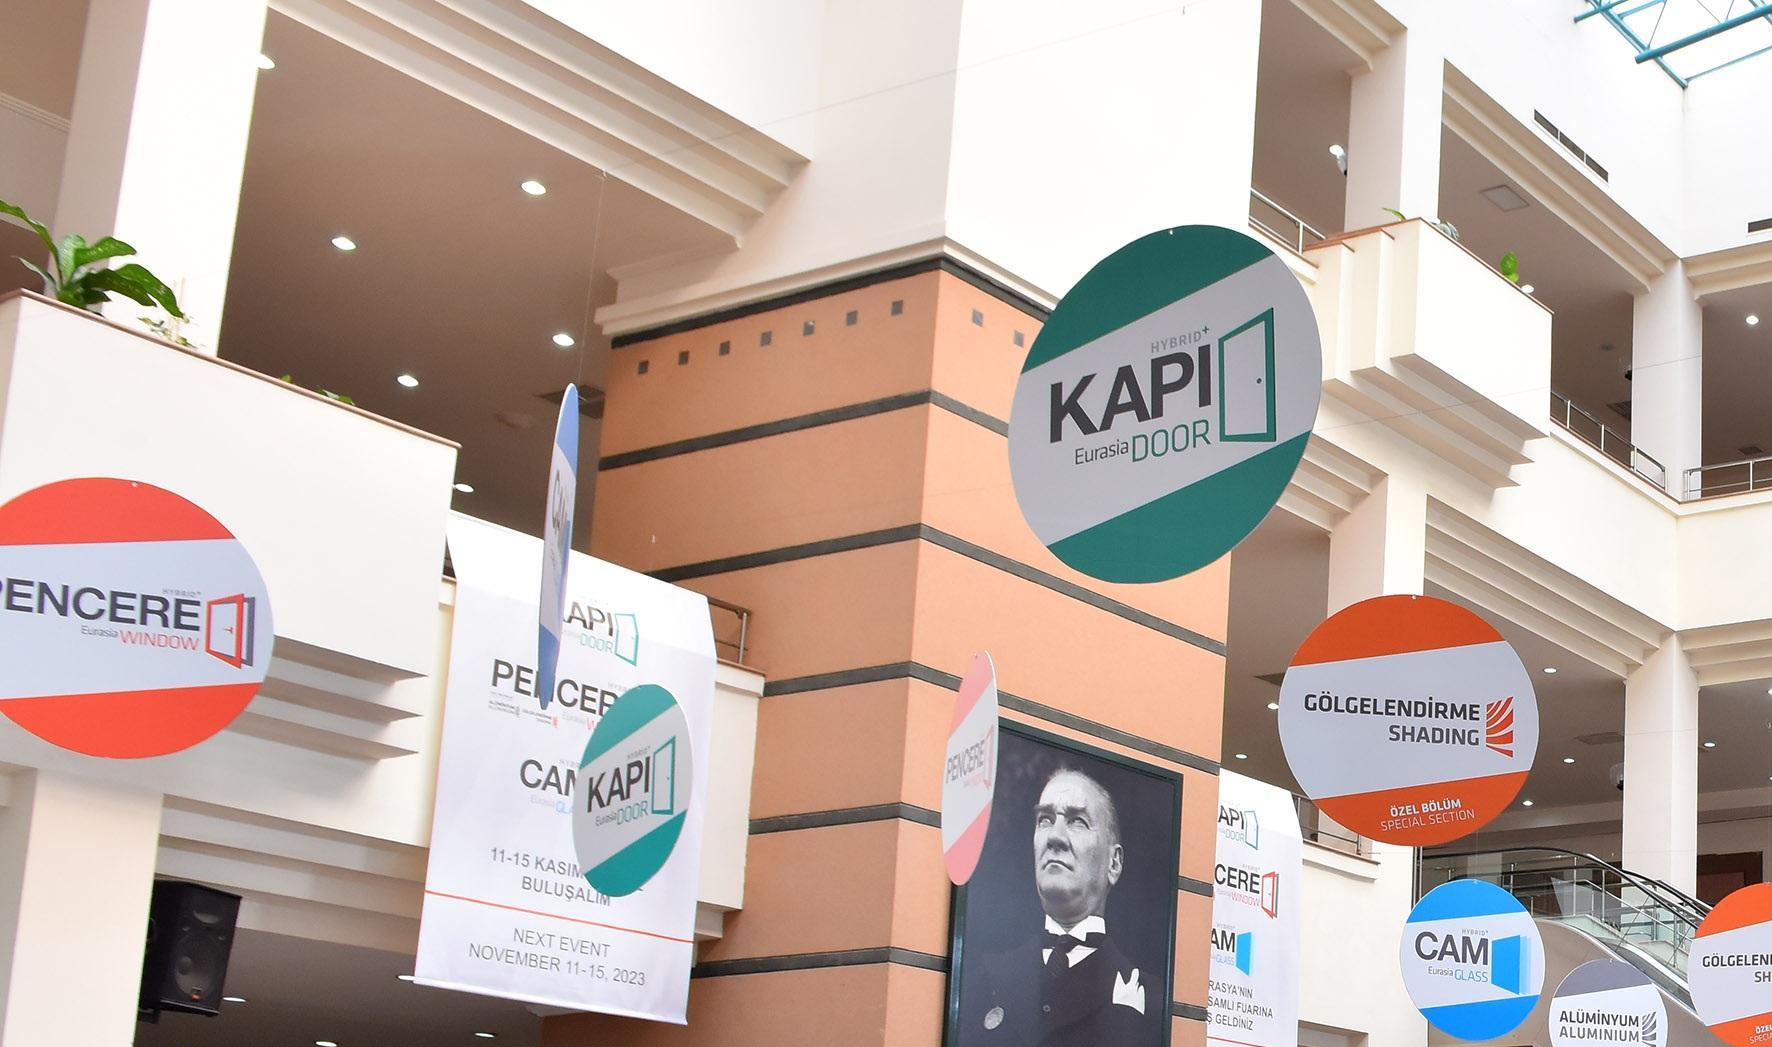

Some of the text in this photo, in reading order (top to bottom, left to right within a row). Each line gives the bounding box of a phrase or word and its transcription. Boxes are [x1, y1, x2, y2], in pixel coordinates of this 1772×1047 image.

[1050, 344, 1211, 443] KAPI
[1075, 419, 1211, 465] Eurasia DOOR
[0, 577, 201, 632] ENCERE
[562, 601, 614, 637] API
[81, 625, 200, 651] Eurasia WINDOW
[1304, 691, 1480, 721] GÖLGELENDİRME
[1389, 725, 1479, 746] SHADING
[586, 756, 651, 813] KAPI
[595, 801, 649, 827] Eurasia DOOR
[1218, 804, 1245, 830] API
[1380, 809, 1475, 832] SPECIAL SECTION
[1390, 799, 1461, 817] ÖZEL BÖLÜM
[491, 848, 530, 868] 11-15
[1214, 864, 1261, 895] CERE
[513, 928, 611, 958] NEXT EVENT
[1211, 928, 1236, 953] AM
[1415, 931, 1489, 966] CAM
[468, 942, 560, 971] NOVEMBER
[613, 968, 646, 986] 2023
[1427, 966, 1489, 983] Eurasia GLASS
[1208, 980, 1253, 999] RASYA'NIN
[1207, 996, 1273, 1019] SAMLI FUARINA
[1559, 1009, 1639, 1028] ALÜMİNYUM
[1215, 1014, 1254, 1031] GELDİNİZ
[1559, 1026, 1640, 1043] ALUMINIUM
